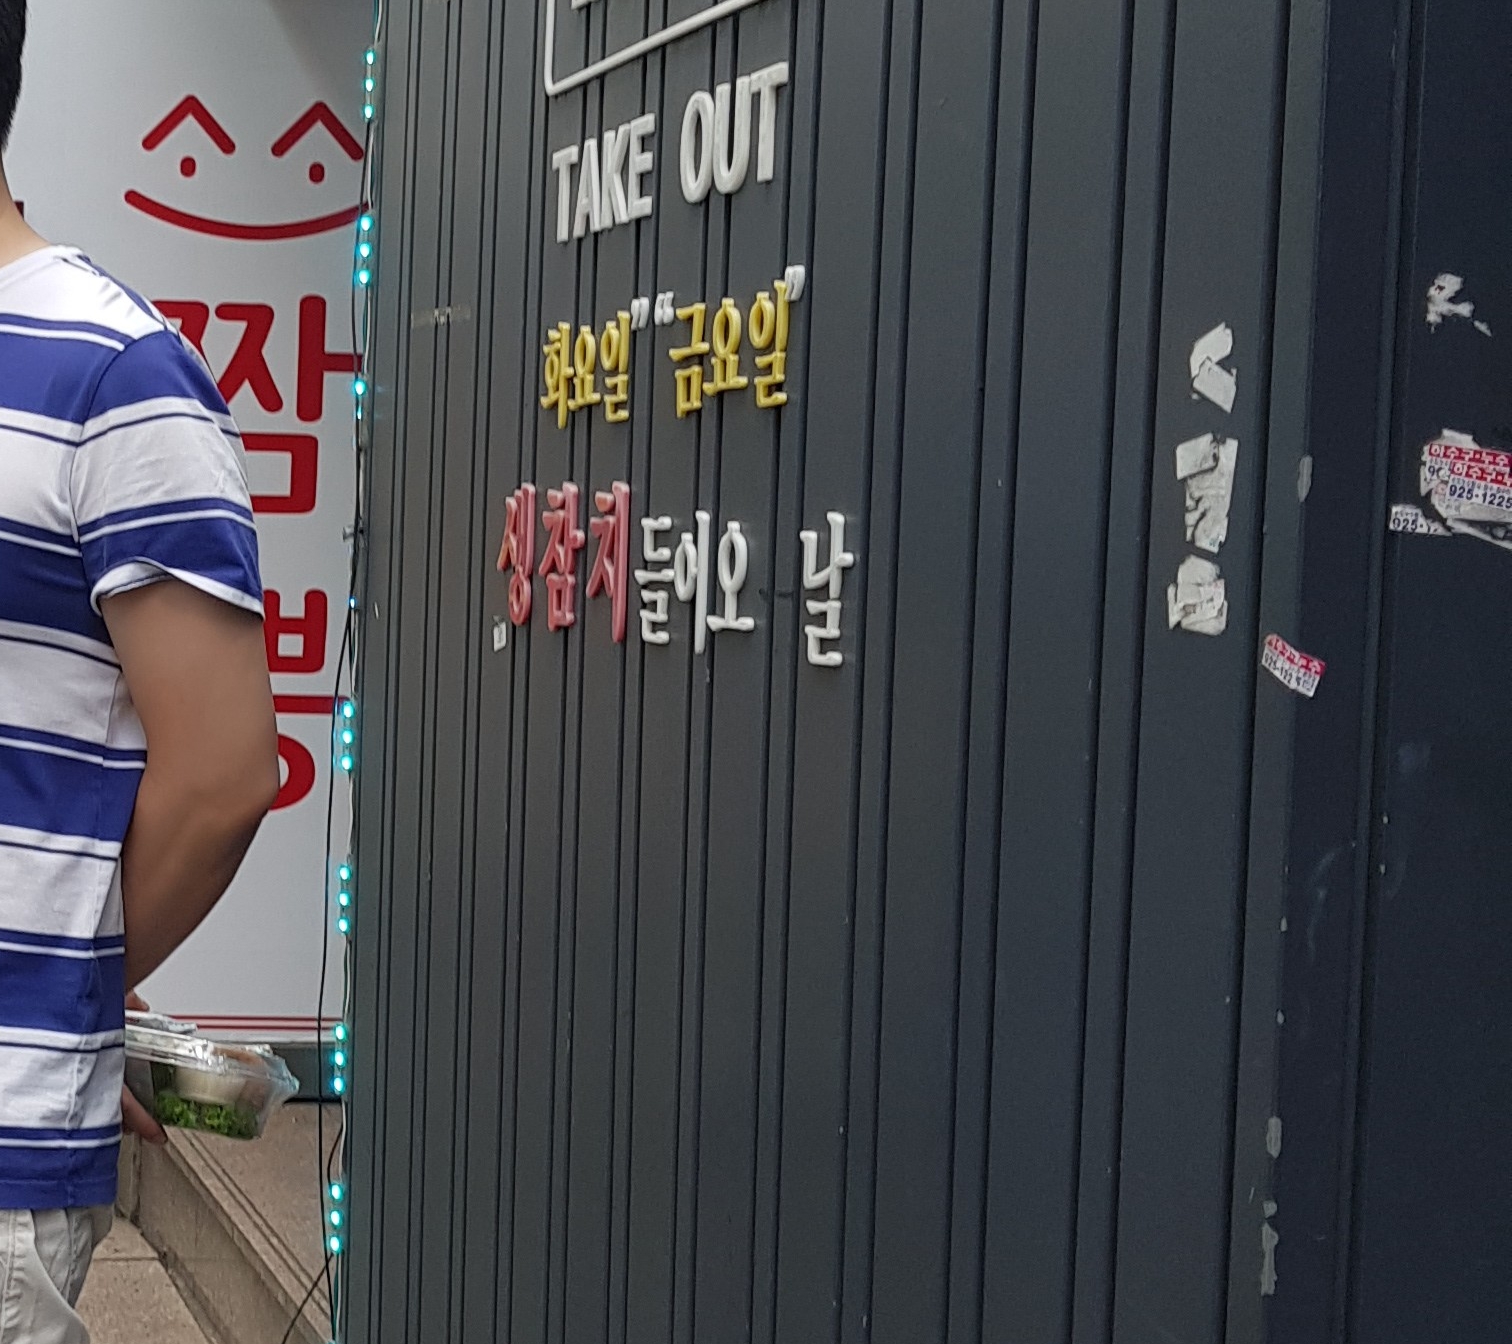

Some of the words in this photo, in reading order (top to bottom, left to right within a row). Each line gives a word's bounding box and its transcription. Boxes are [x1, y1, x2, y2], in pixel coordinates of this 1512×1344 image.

[552, 113, 656, 243] TAKE
[680, 62, 789, 204] OUT
[801, 511, 854, 667] 날
